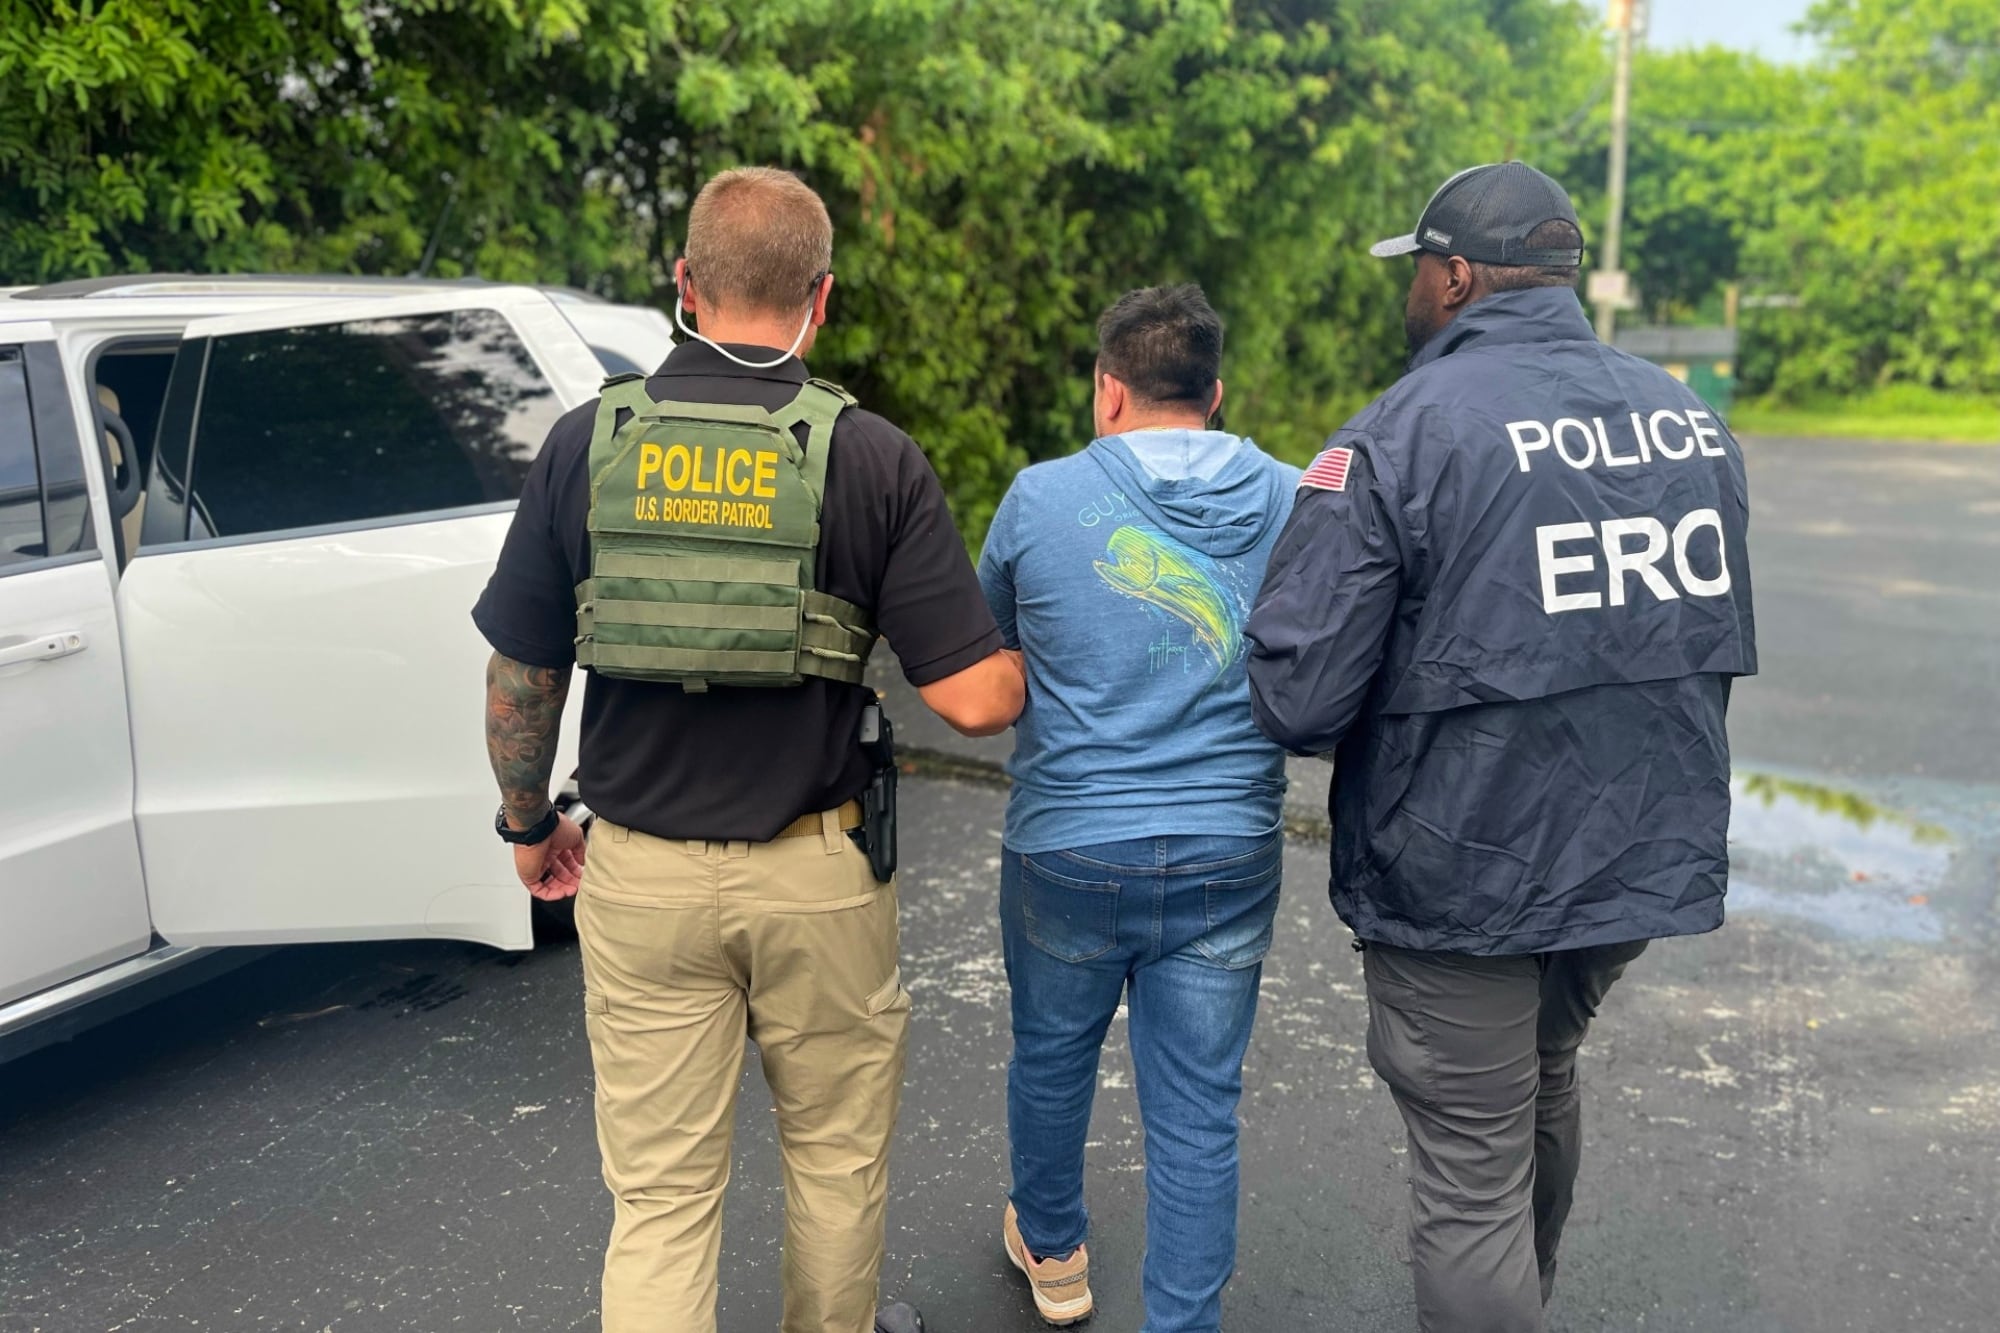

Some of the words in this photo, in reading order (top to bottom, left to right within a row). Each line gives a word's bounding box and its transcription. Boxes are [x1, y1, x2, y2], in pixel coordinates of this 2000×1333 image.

[1505, 409, 1726, 472] POLICE
[637, 443, 778, 498] POLICE
[635, 496, 660, 521] U.S.
[663, 497, 718, 525] BORDER
[721, 501, 773, 529] PATROL
[1078, 492, 1127, 527] GUY
[1536, 508, 1731, 614] ERO
